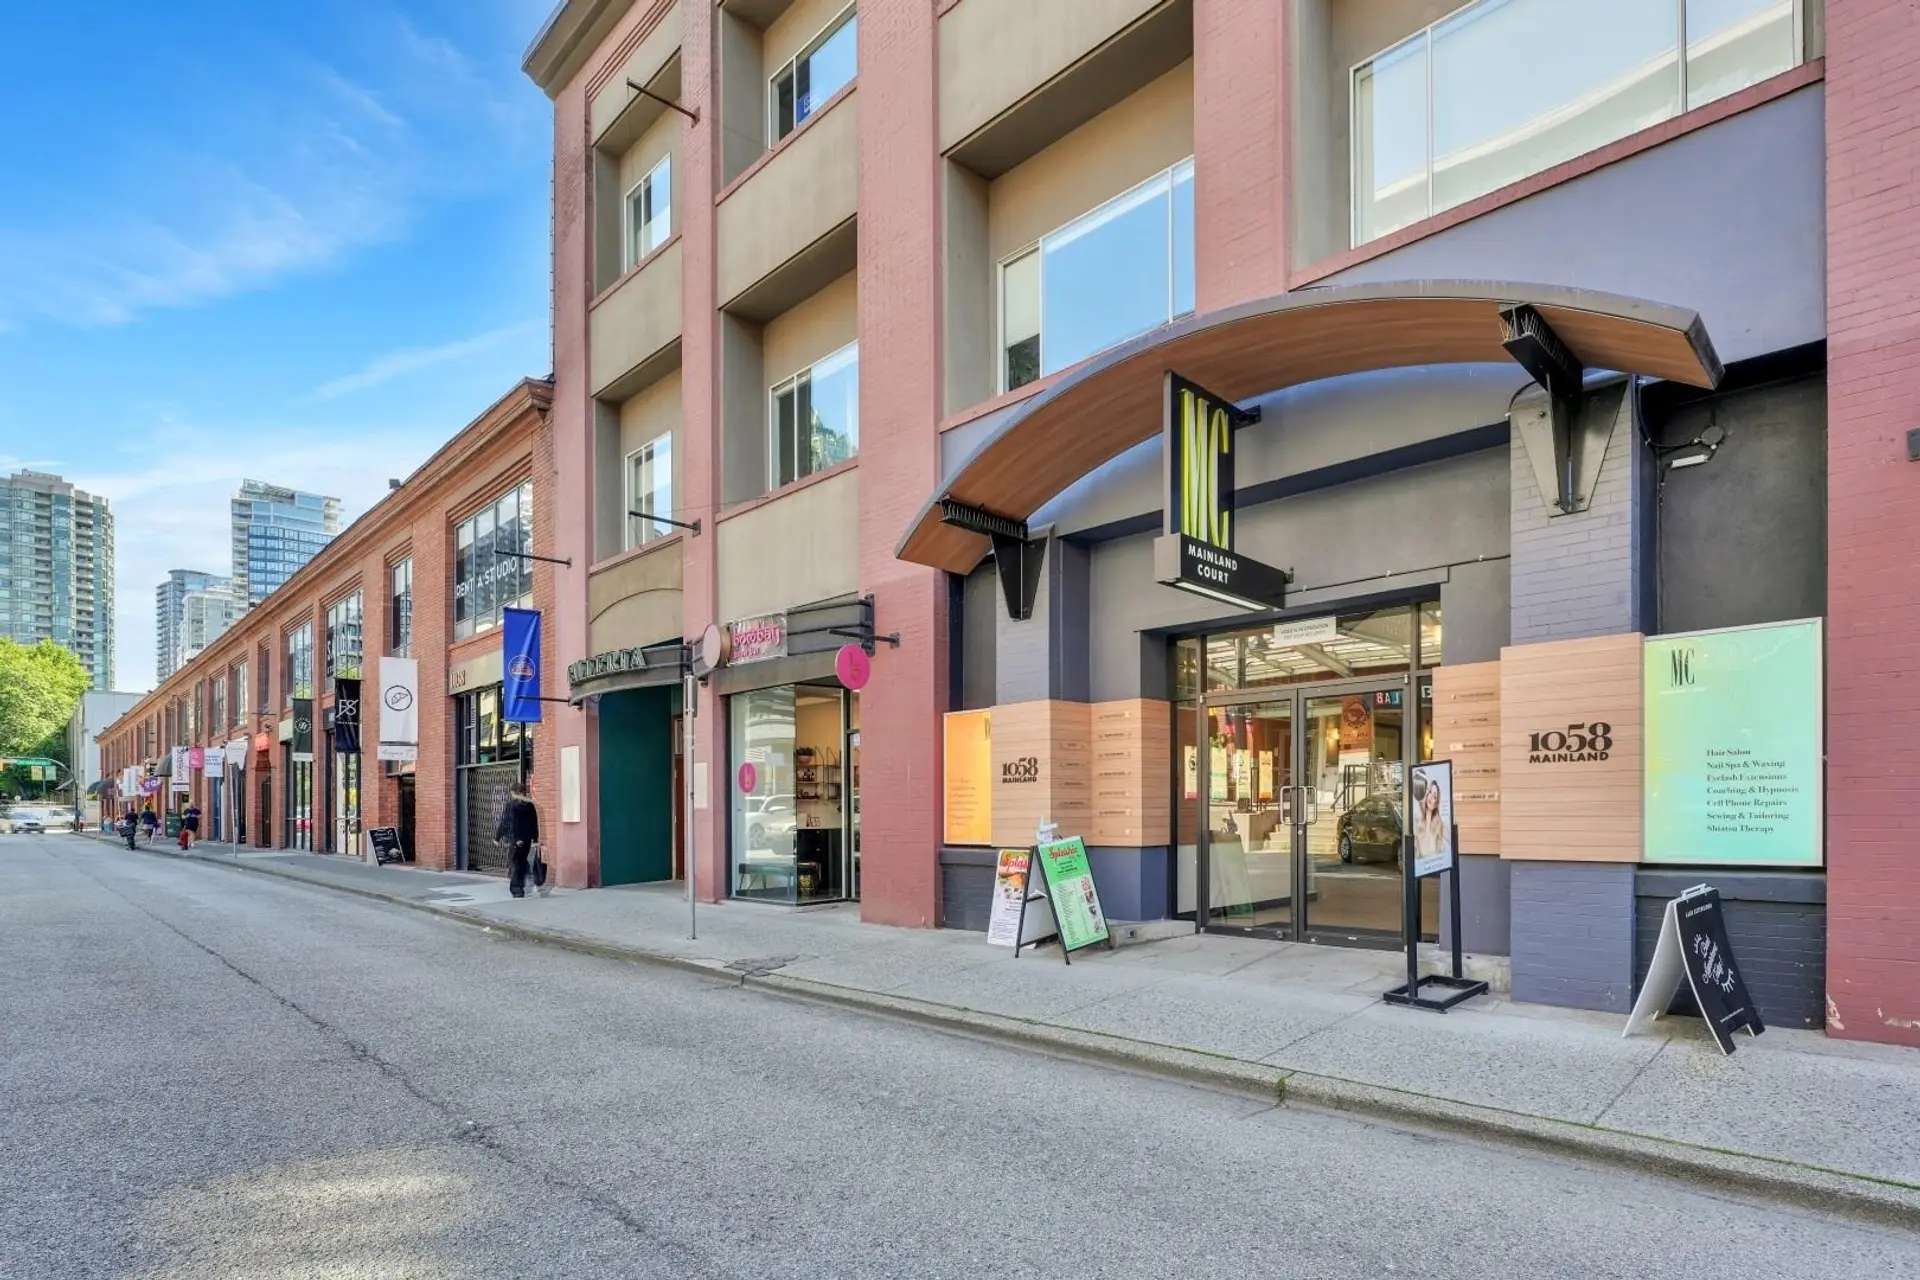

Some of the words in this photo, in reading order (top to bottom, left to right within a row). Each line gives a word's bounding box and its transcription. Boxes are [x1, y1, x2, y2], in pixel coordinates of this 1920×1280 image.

[1188, 543, 1238, 572] MAINLAND
[456, 577, 474, 599] RENT
[477, 576, 484, 589] A
[484, 556, 517, 585] STUDIO
[1197, 564, 1229, 585] COURT
[1528, 722, 1613, 753] 1058
[1529, 751, 1609, 763] MAINLAND
[1706, 749, 1726, 757] Hair
[1727, 748, 1751, 756] Salon
[1002, 756, 1039, 778] 1058
[1725, 762, 1740, 770] Spa
[1752, 760, 1785, 769] Waxing
[1002, 776, 1037, 784] MAINLAND
[1706, 774, 1738, 782] Eyelash
[1739, 773, 1787, 781] Extensions
[1706, 786, 1746, 795] Coaching
[1758, 785, 1799, 795] Hypnosis
[1706, 799, 1723, 807] Cell
[1725, 799, 1751, 807] Phone
[1753, 799, 1787, 808] Repairs
[1706, 812, 1737, 821] Sewing
[1749, 811, 1789, 821] Tailoring
[1740, 824, 1774, 834] Therapy
